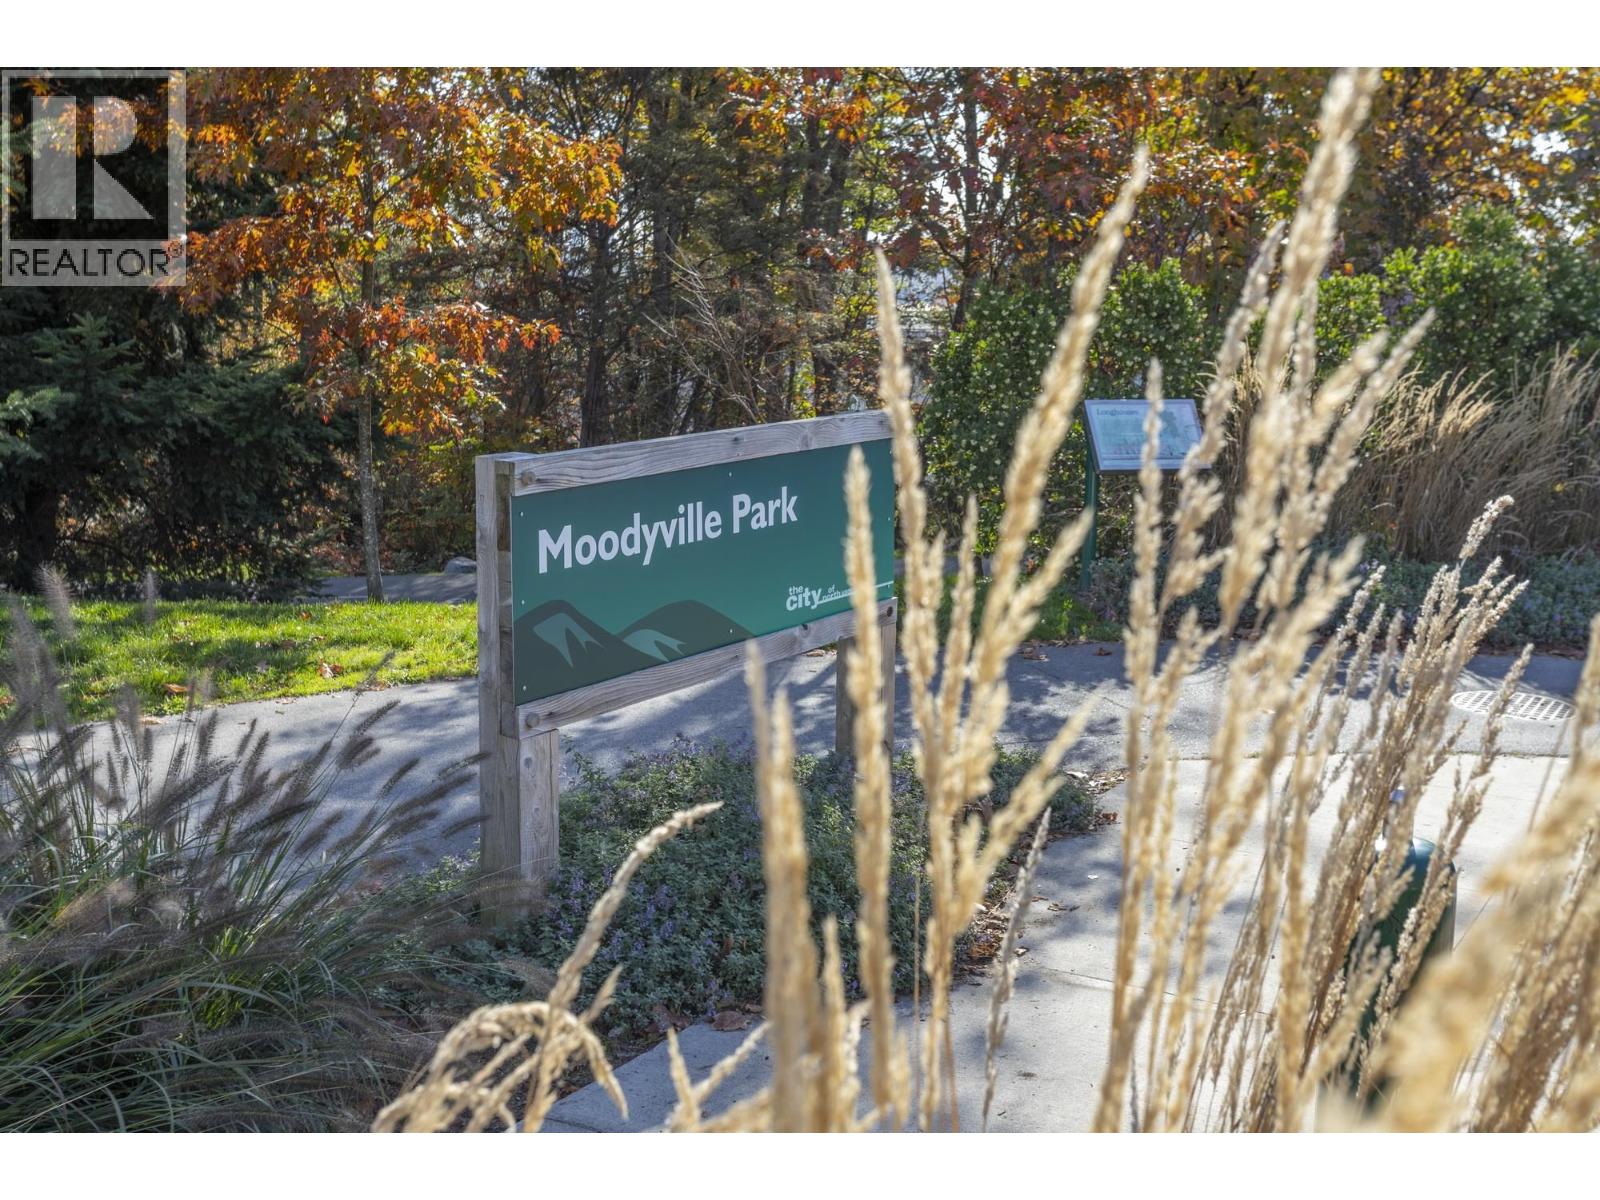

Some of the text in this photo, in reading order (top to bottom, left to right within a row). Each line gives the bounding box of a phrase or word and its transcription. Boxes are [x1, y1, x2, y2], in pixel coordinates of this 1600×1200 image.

[538, 486, 798, 574] Moodyville Park
[789, 585, 803, 595] the
[828, 584, 836, 594] of
[786, 587, 822, 611] city
